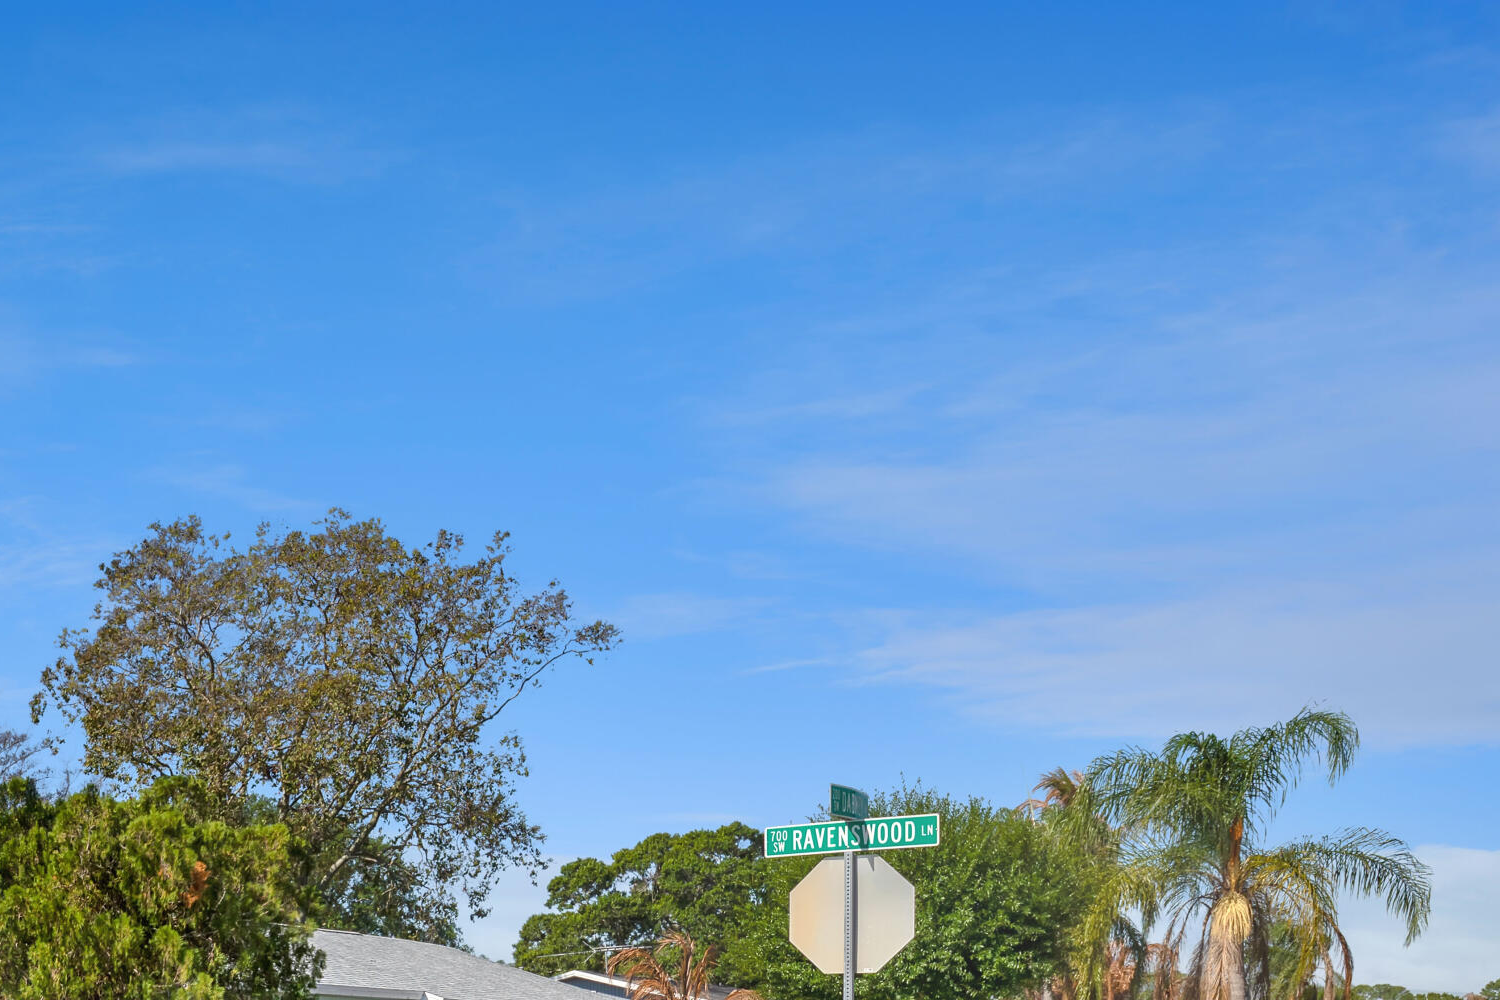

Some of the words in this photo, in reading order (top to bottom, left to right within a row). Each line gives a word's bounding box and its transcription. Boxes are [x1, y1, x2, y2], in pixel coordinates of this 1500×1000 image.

[770, 830, 788, 842] 700
[792, 821, 916, 851] RAVENSWOOD
[921, 824, 934, 837] LN
[773, 841, 786, 854] SW
